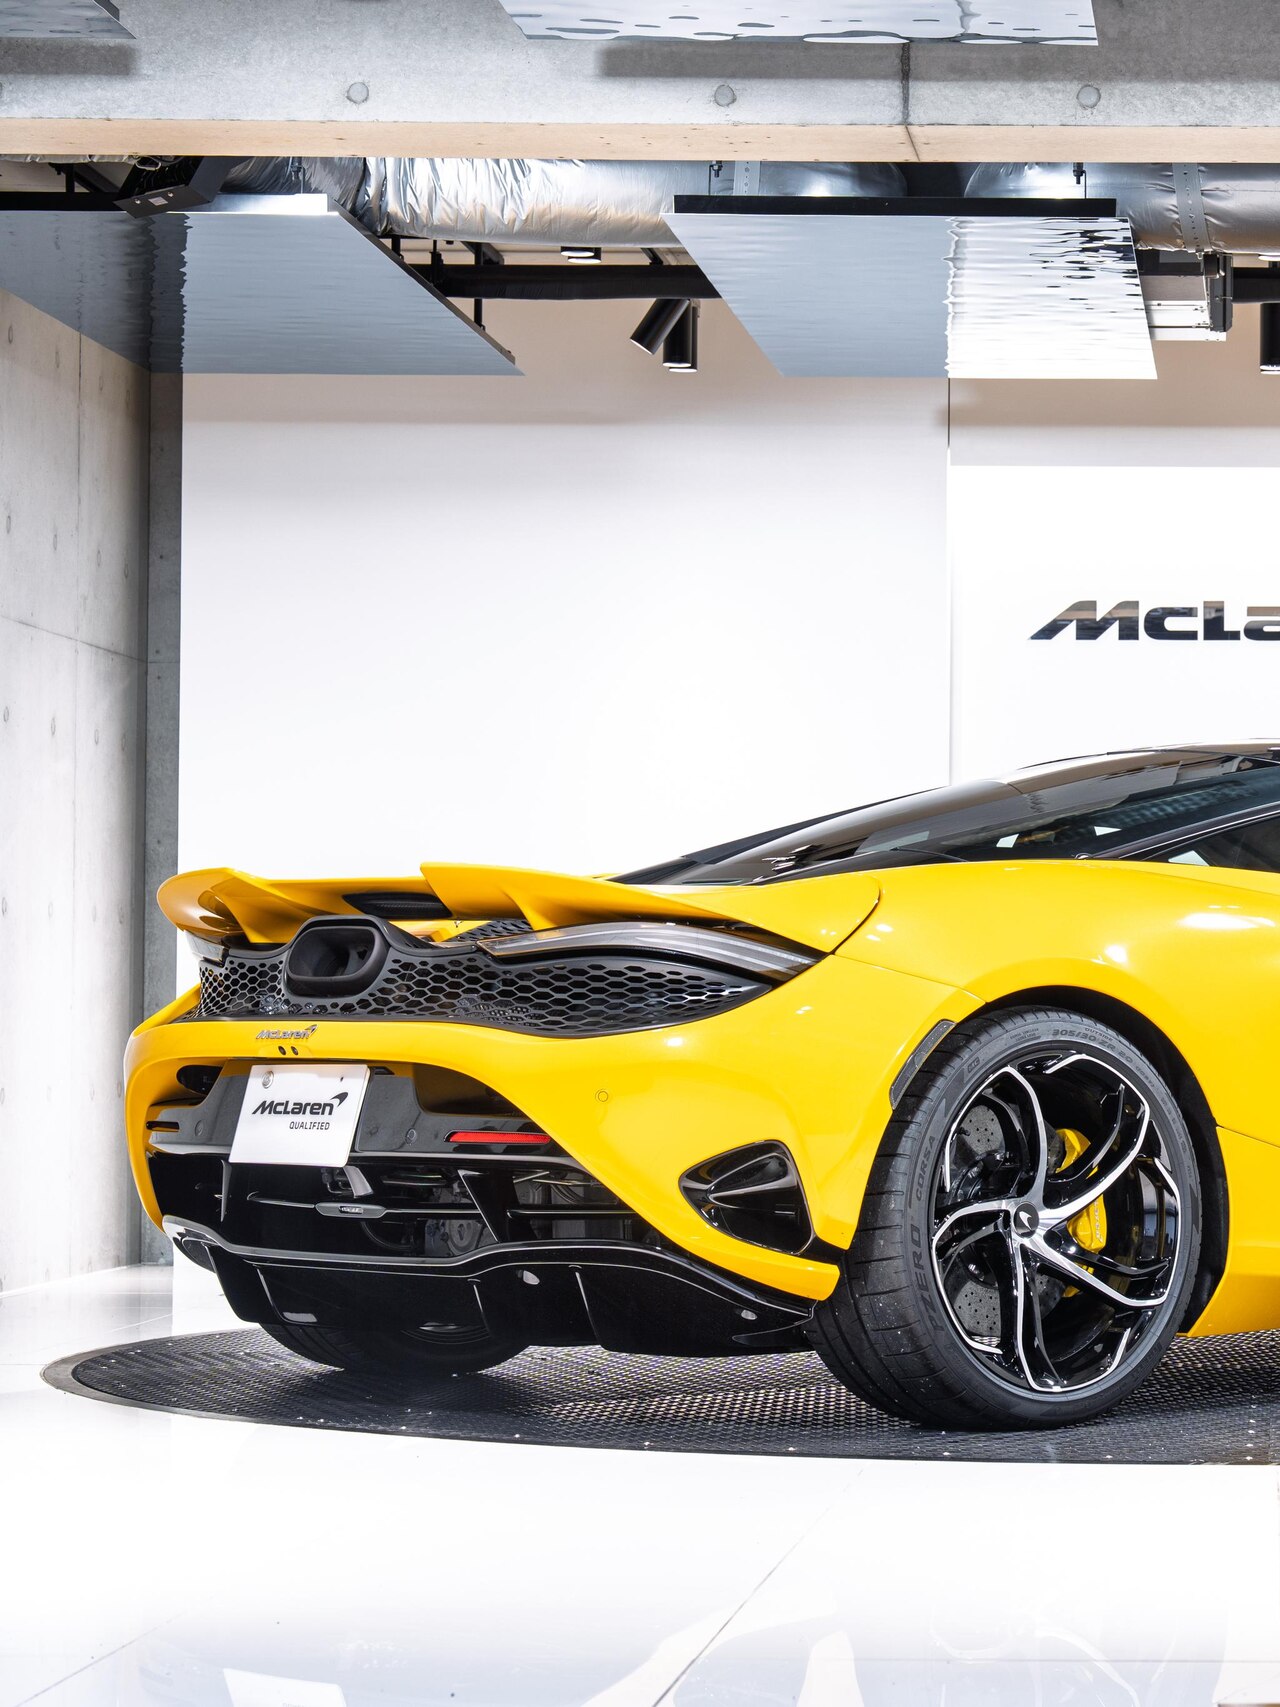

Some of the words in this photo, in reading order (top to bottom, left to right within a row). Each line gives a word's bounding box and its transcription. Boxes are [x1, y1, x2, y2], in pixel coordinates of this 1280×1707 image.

[255, 1030, 310, 1040] McLaren
[1051, 1028, 1097, 1042] 305/30
[252, 1100, 334, 1115] McLaren
[289, 1121, 330, 1130] QUALIFIED
[916, 1135, 935, 1202] CORSA
